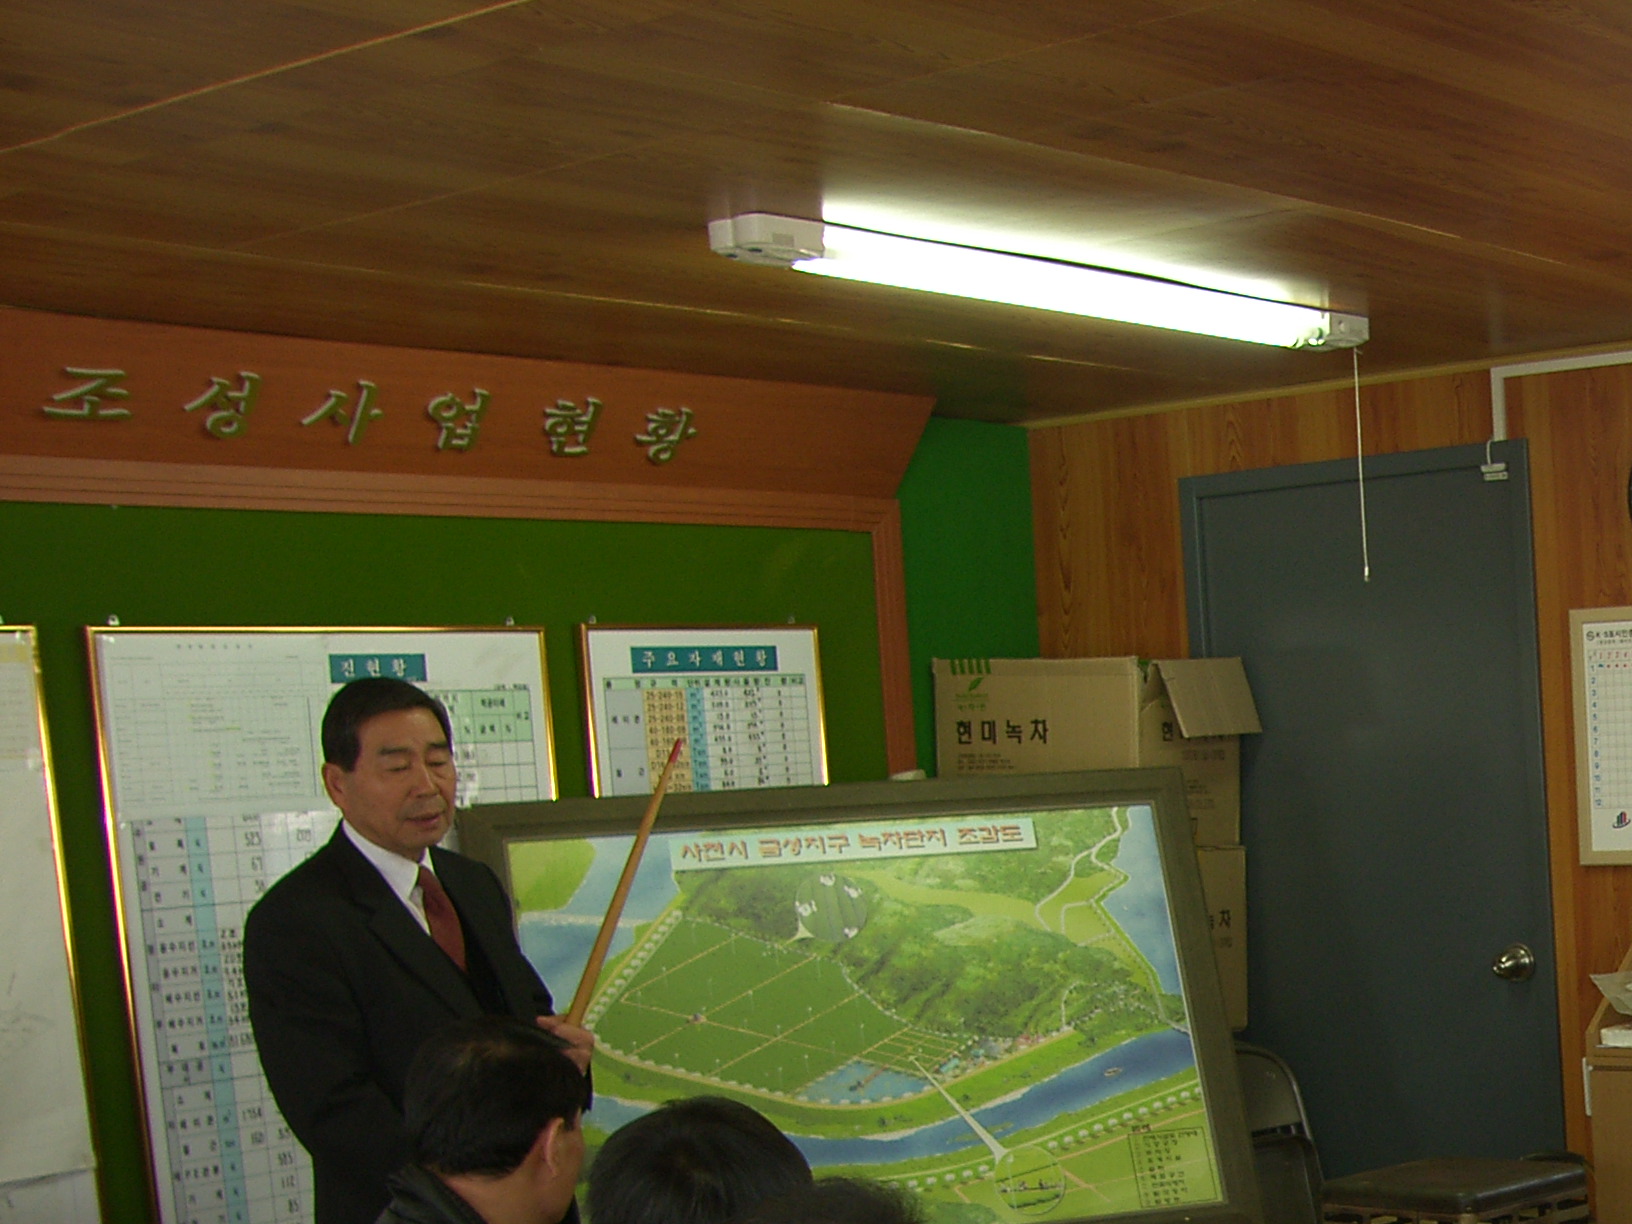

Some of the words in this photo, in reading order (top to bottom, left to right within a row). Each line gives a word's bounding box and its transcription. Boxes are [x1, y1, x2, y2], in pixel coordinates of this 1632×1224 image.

[956, 719, 1049, 745] 현미녹차
[680, 838, 749, 863] 사천시
[758, 833, 850, 858] 금성지구
[858, 827, 947, 852] 녹차단지
[956, 823, 1025, 846] 조감도
